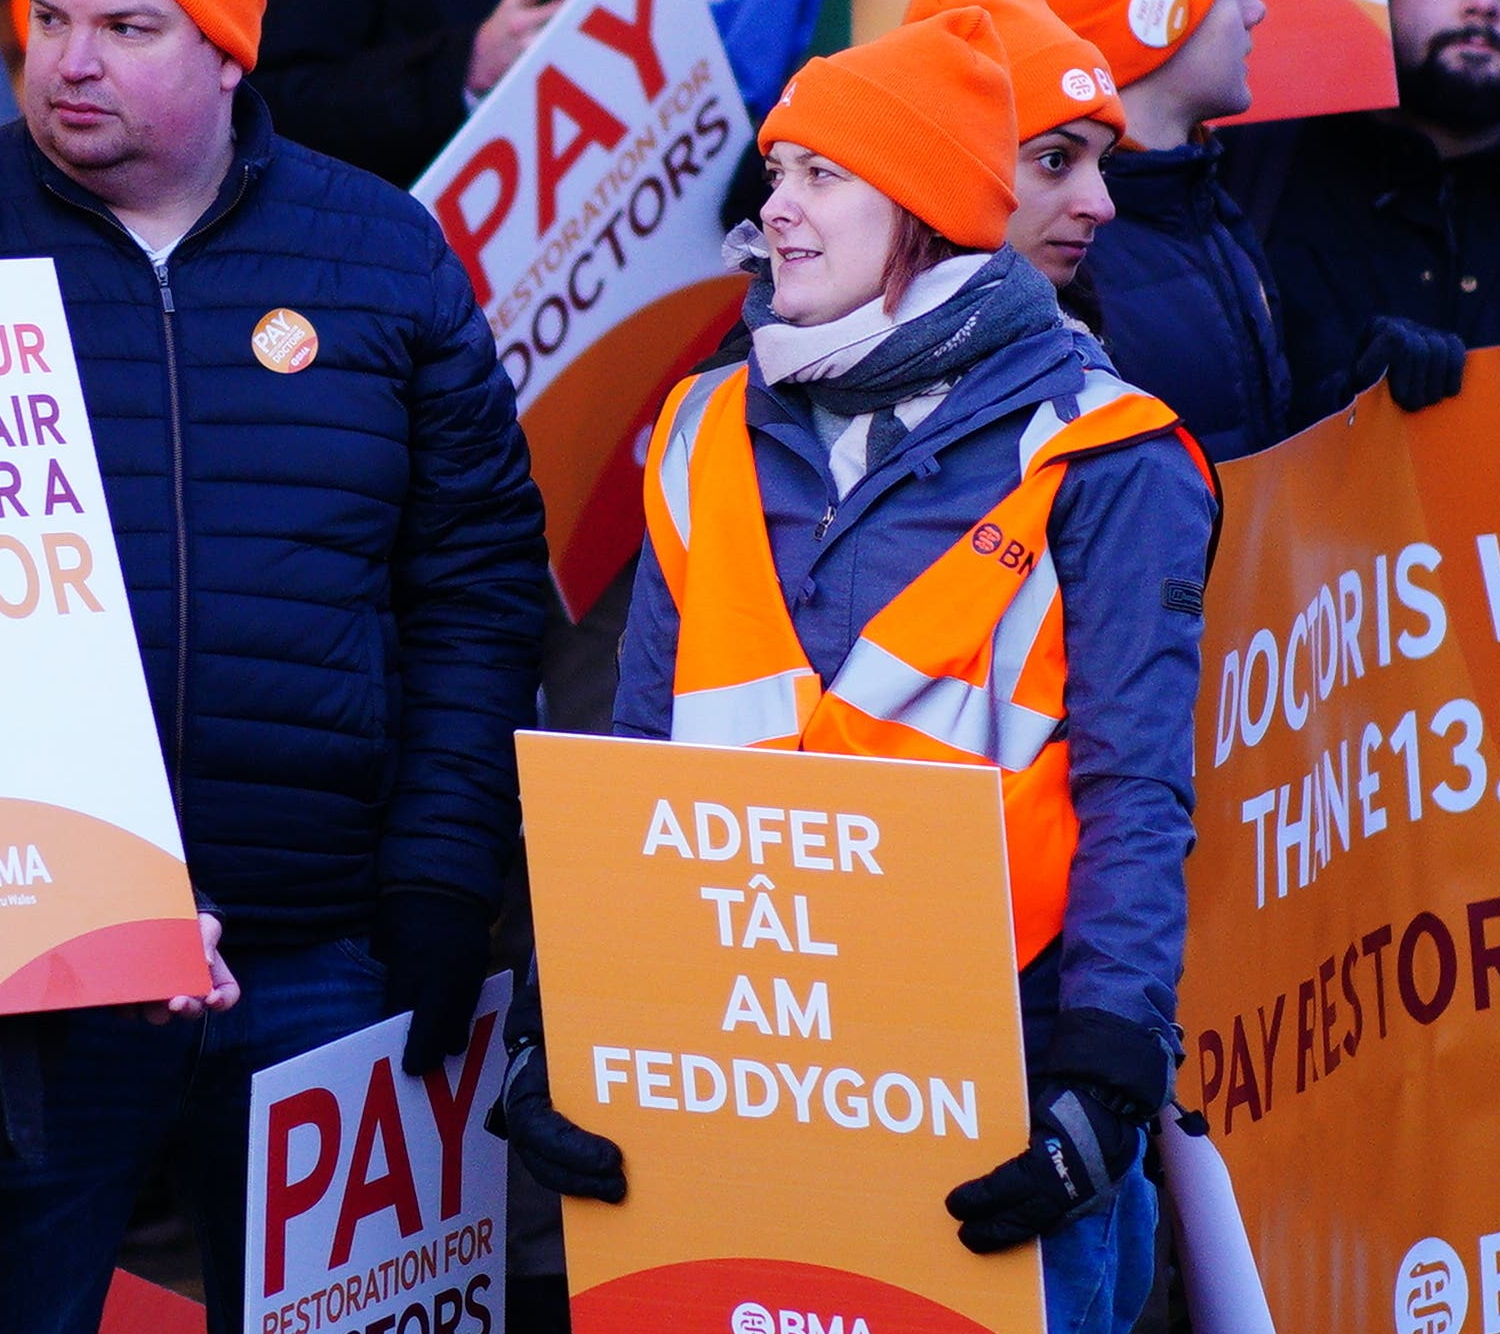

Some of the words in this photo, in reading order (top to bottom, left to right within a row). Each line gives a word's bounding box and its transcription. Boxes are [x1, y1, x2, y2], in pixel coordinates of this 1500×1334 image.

[253, 310, 291, 354] PAY
[43, 457, 85, 516] A
[1213, 567, 1364, 770] DOCTOR
[1375, 541, 1449, 667] IS
[642, 797, 885, 877] ADFER
[1241, 756, 1351, 910] THAN
[699, 872, 839, 958] TÂL
[720, 973, 833, 1042] AM
[592, 1044, 980, 1141] FEDDYGON
[1199, 993, 1287, 1137] PAY
[263, 1011, 498, 1301] PAY
[443, 1215, 494, 1267] FOR
